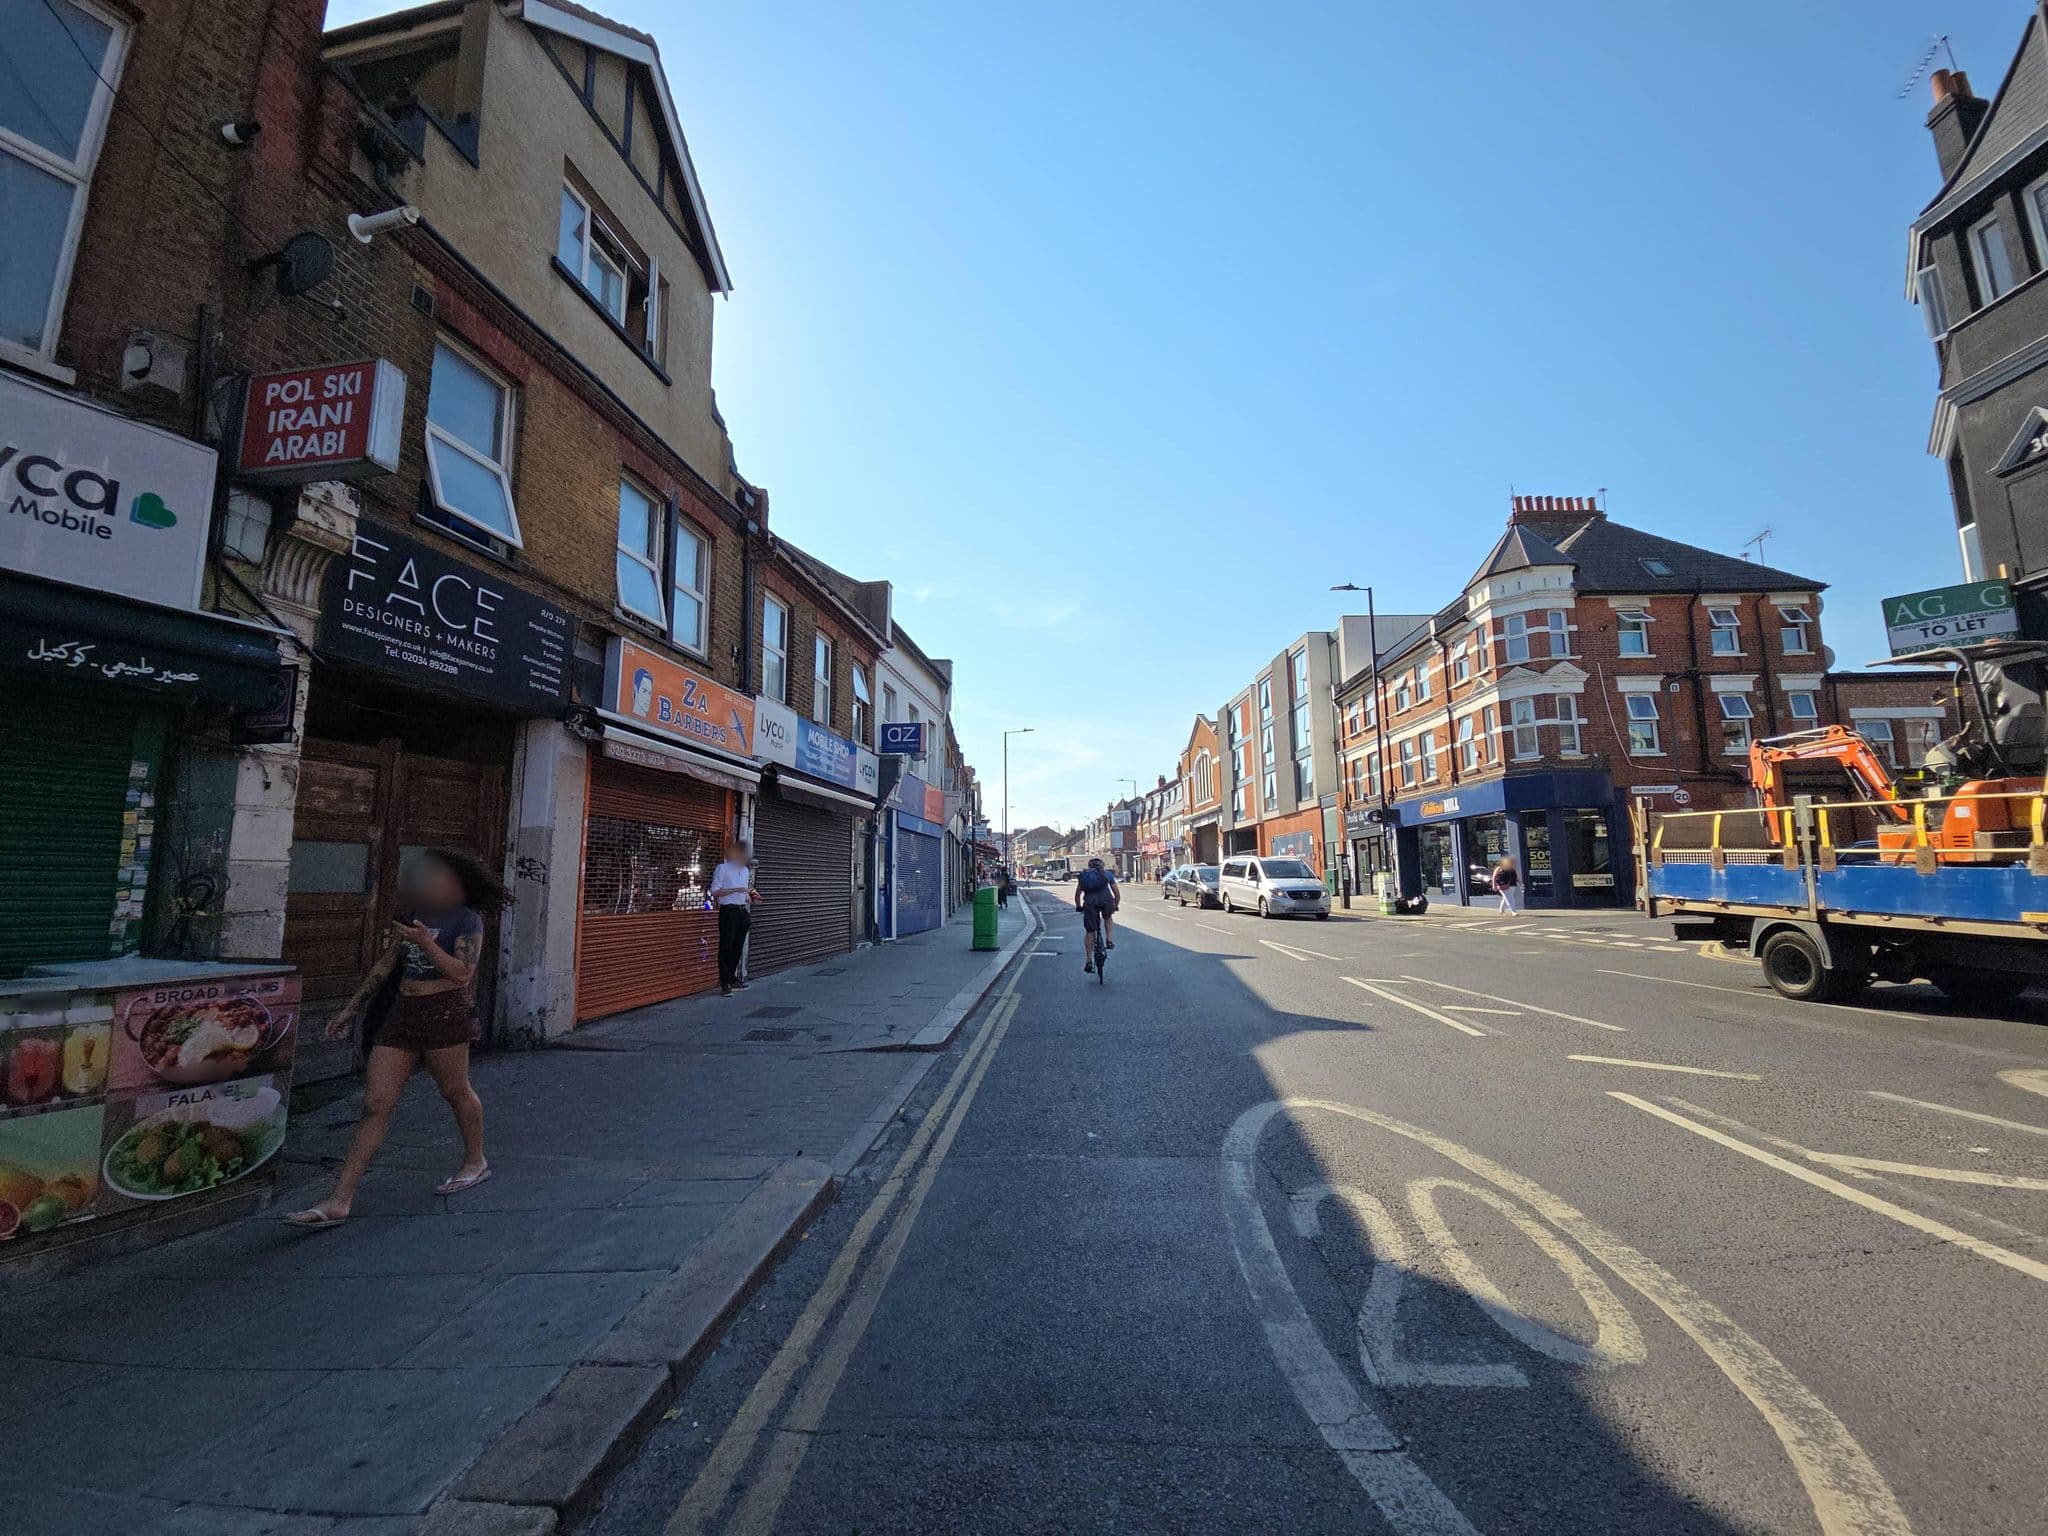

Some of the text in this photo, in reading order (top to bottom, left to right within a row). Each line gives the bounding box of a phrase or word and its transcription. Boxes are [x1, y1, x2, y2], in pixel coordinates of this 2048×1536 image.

[267, 401, 353, 433] IRANI
[264, 429, 346, 462] ARABI
[0, 446, 120, 516] ca
[9, 496, 113, 539] Mobile
[348, 535, 504, 643] FACE
[341, 622, 422, 652] www.facejoinery.co.uk
[343, 598, 431, 638] DESIGNERS
[447, 633, 496, 660] MAKERS
[1893, 622, 1929, 632] GROUND
[1920, 618, 1987, 638] TO LET
[102, 656, 154, 678] طبيعي
[385, 645, 400, 658] Tel.
[401, 652, 428, 666] 02034
[154, 669, 200, 684] عصير
[760, 713, 785, 739] Lyca
[807, 728, 850, 760] MOBILE SHOP
[1443, 797, 1460, 812] HILL
[1675, 792, 1688, 800] 20
[155, 987, 218, 1003] BROAD
[1289, 1176, 1648, 1388] 20
